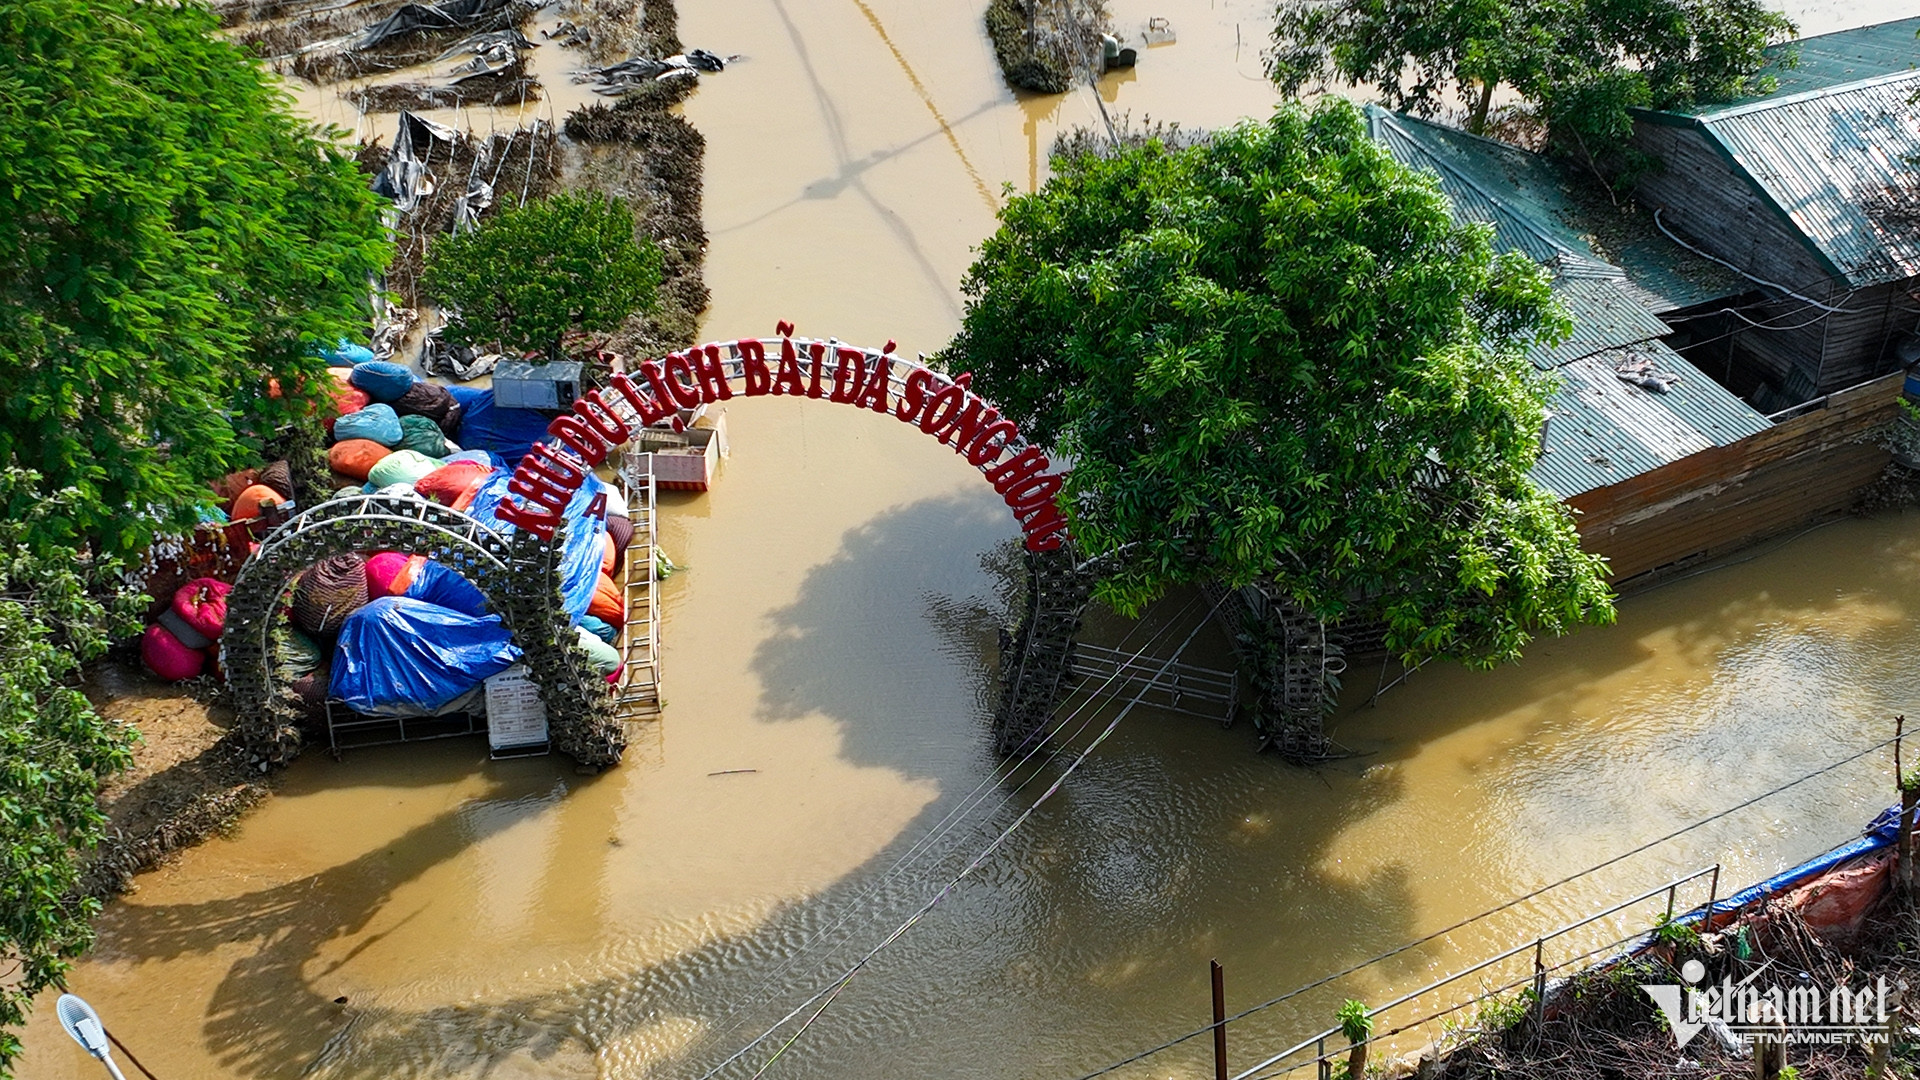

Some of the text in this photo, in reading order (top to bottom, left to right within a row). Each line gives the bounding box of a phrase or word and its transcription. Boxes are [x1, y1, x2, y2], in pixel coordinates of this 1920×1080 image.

[495, 442, 583, 542] KHU
[547, 389, 629, 468] DU
[611, 344, 732, 434] LỊCH
[738, 319, 825, 397] BÃI
[830, 339, 896, 413] ĐÁ
